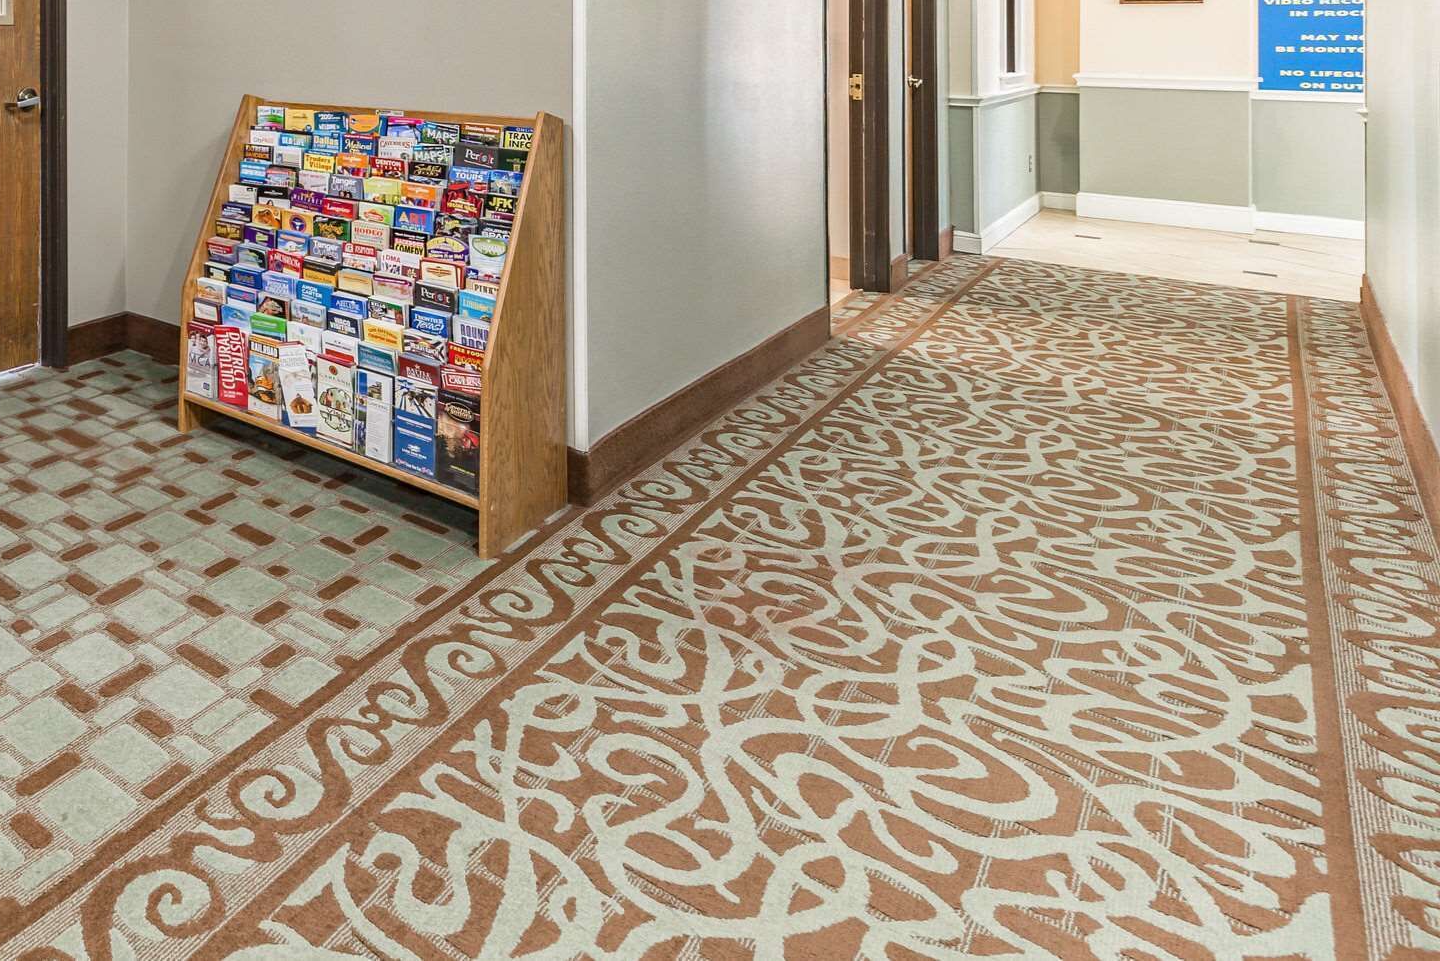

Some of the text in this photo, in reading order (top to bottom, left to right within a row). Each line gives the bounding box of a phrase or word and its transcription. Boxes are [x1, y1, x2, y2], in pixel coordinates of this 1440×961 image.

[1299, 82, 1326, 90] ON
[427, 128, 458, 144] MAPS
[465, 148, 494, 165] Perot
[332, 176, 357, 187] Tanger
[455, 171, 484, 181] TOURS
[488, 196, 513, 209] JFK
[398, 211, 427, 226] ART
[353, 227, 384, 238] RODEO
[314, 240, 339, 251] Tanger
[394, 243, 424, 256] COMEDY
[421, 288, 451, 303] Perot
[250, 341, 278, 358] RAILROAD
[450, 345, 465, 354] FREE
[216, 332, 236, 390] CULTURAL
[228, 332, 246, 384] DISTRICT
